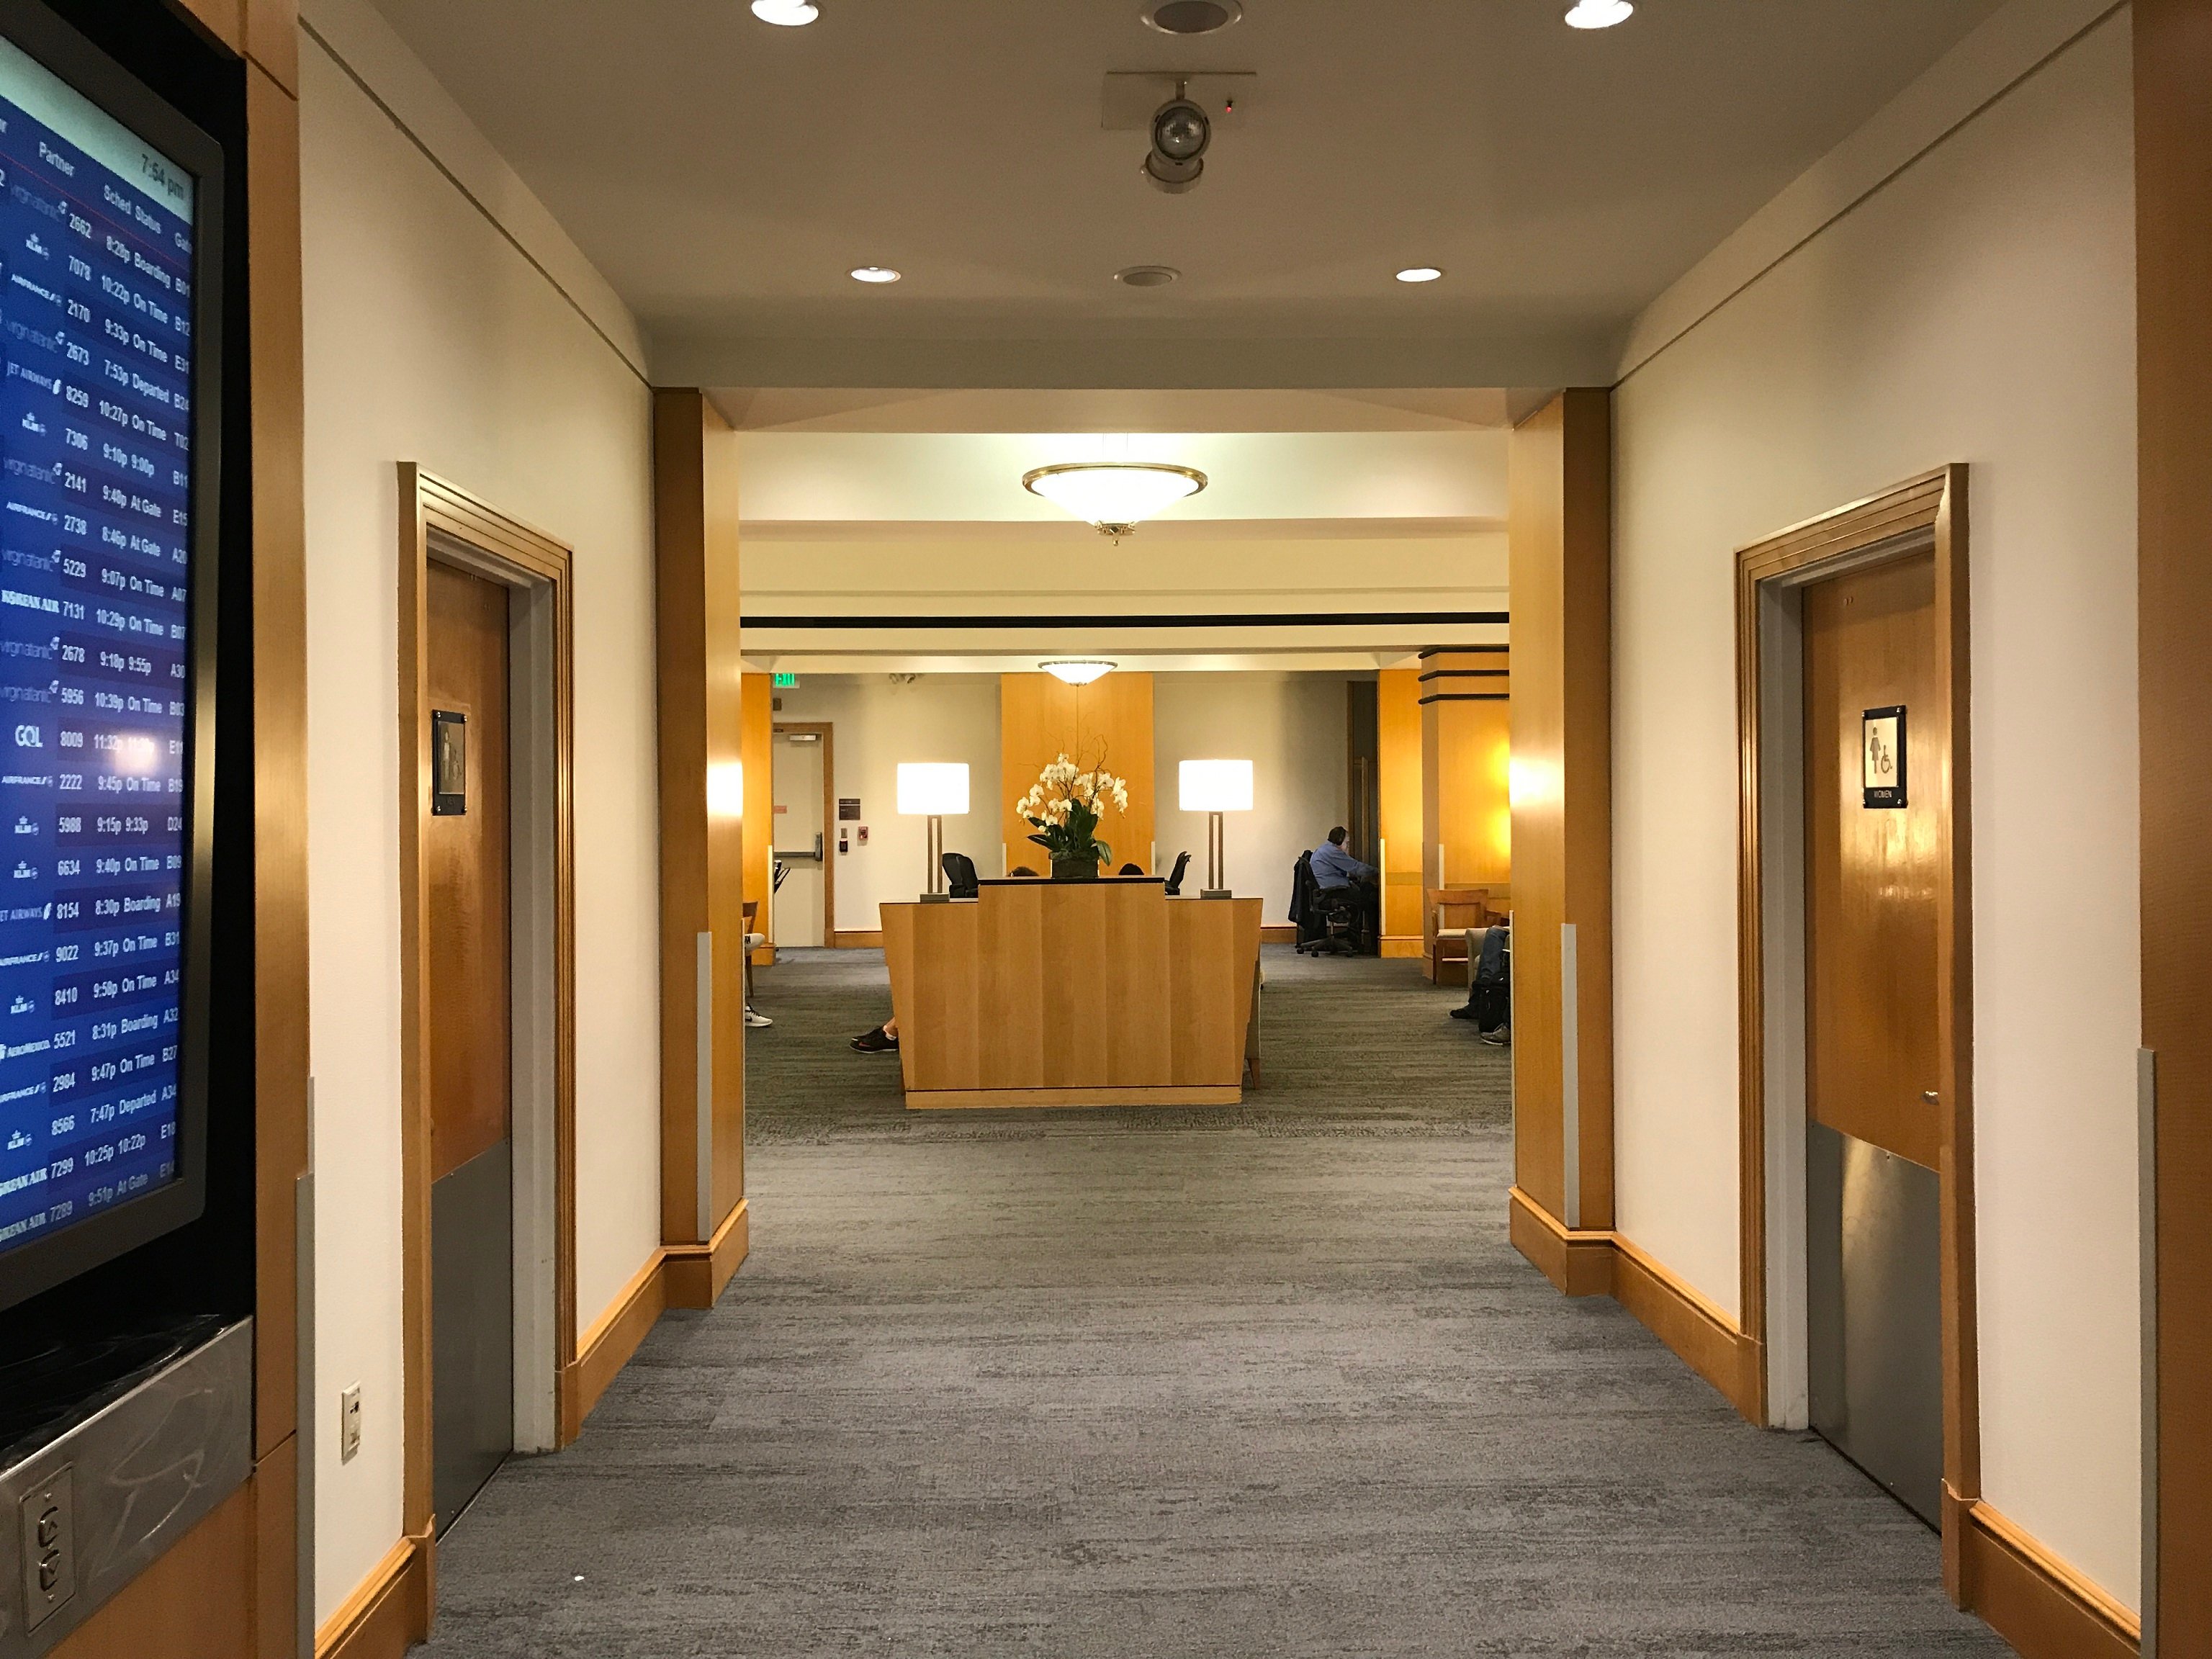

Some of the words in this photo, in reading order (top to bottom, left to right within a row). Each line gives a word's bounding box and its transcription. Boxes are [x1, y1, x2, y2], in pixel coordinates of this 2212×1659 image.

[40, 141, 74, 176] Partner
[104, 184, 131, 215] Sched
[135, 205, 161, 234] Status
[142, 153, 166, 187] 7:54
[168, 177, 185, 202] pm
[70, 213, 91, 239] 2662
[135, 252, 171, 289] Boarding
[102, 275, 130, 305] 10:22p
[134, 293, 146, 313] On
[148, 300, 168, 324] Time
[68, 299, 91, 323] 2170
[105, 318, 129, 346] 9:33p
[133, 333, 146, 353] On
[148, 340, 168, 363] Time
[67, 341, 89, 366] 2673
[104, 359, 129, 387] 7:53p
[132, 373, 170, 403] Departed
[100, 400, 128, 427] 10:27p
[132, 414, 145, 432] On
[146, 420, 166, 441] Time
[65, 472, 86, 493] 2141
[131, 495, 141, 511] At
[142, 498, 162, 518] Gate
[65, 514, 87, 535] 2738
[130, 535, 141, 551] At
[142, 538, 161, 557] Gate
[63, 557, 86, 578] 5229
[102, 568, 126, 590] 9:07p
[130, 575, 143, 592] On
[144, 579, 164, 598] Time
[63, 601, 85, 620] 7131
[96, 608, 125, 631] 10:29p
[129, 616, 143, 632] On
[144, 618, 164, 636] Time
[63, 644, 86, 663] 2678
[101, 650, 125, 673] 9:18p
[61, 687, 84, 705] 5956
[128, 696, 141, 711] On
[143, 697, 163, 714] Time
[15, 724, 43, 747] GOL
[60, 730, 84, 748] 8009
[60, 774, 83, 791] 2222
[98, 775, 123, 793] 9:45p
[127, 777, 140, 791] On
[141, 777, 161, 792] Time
[1874, 790, 1892, 799] WOMEN
[97, 817, 122, 835] 9:15p
[125, 817, 149, 835] 9:33p
[58, 860, 81, 876] 6634
[125, 857, 138, 872] On
[140, 856, 160, 871] Time
[9, 906, 42, 921] AIRWAYS
[57, 902, 80, 920] 8154
[124, 896, 161, 913] Boarding
[56, 945, 79, 963] 9022
[94, 939, 119, 958] 9:37p
[123, 938, 136, 953] On
[138, 935, 158, 950] Time
[55, 986, 78, 1006] 8410
[122, 977, 135, 993] On
[137, 975, 157, 990] Time
[53, 1030, 76, 1049] 5521
[92, 1022, 117, 1040] 8:31p
[121, 1014, 158, 1034] Boarding
[91, 1062, 116, 1082] 9:47p
[120, 1058, 133, 1074] On
[135, 1053, 155, 1069] Time
[90, 1104, 115, 1123] 7:47p
[120, 1089, 157, 1115] Departed
[84, 1144, 114, 1166] 10:25p
[118, 1133, 146, 1155] 10:22p
[88, 1186, 114, 1208] 9:51p
[117, 1180, 127, 1196] At
[128, 1174, 148, 1191] Gate
